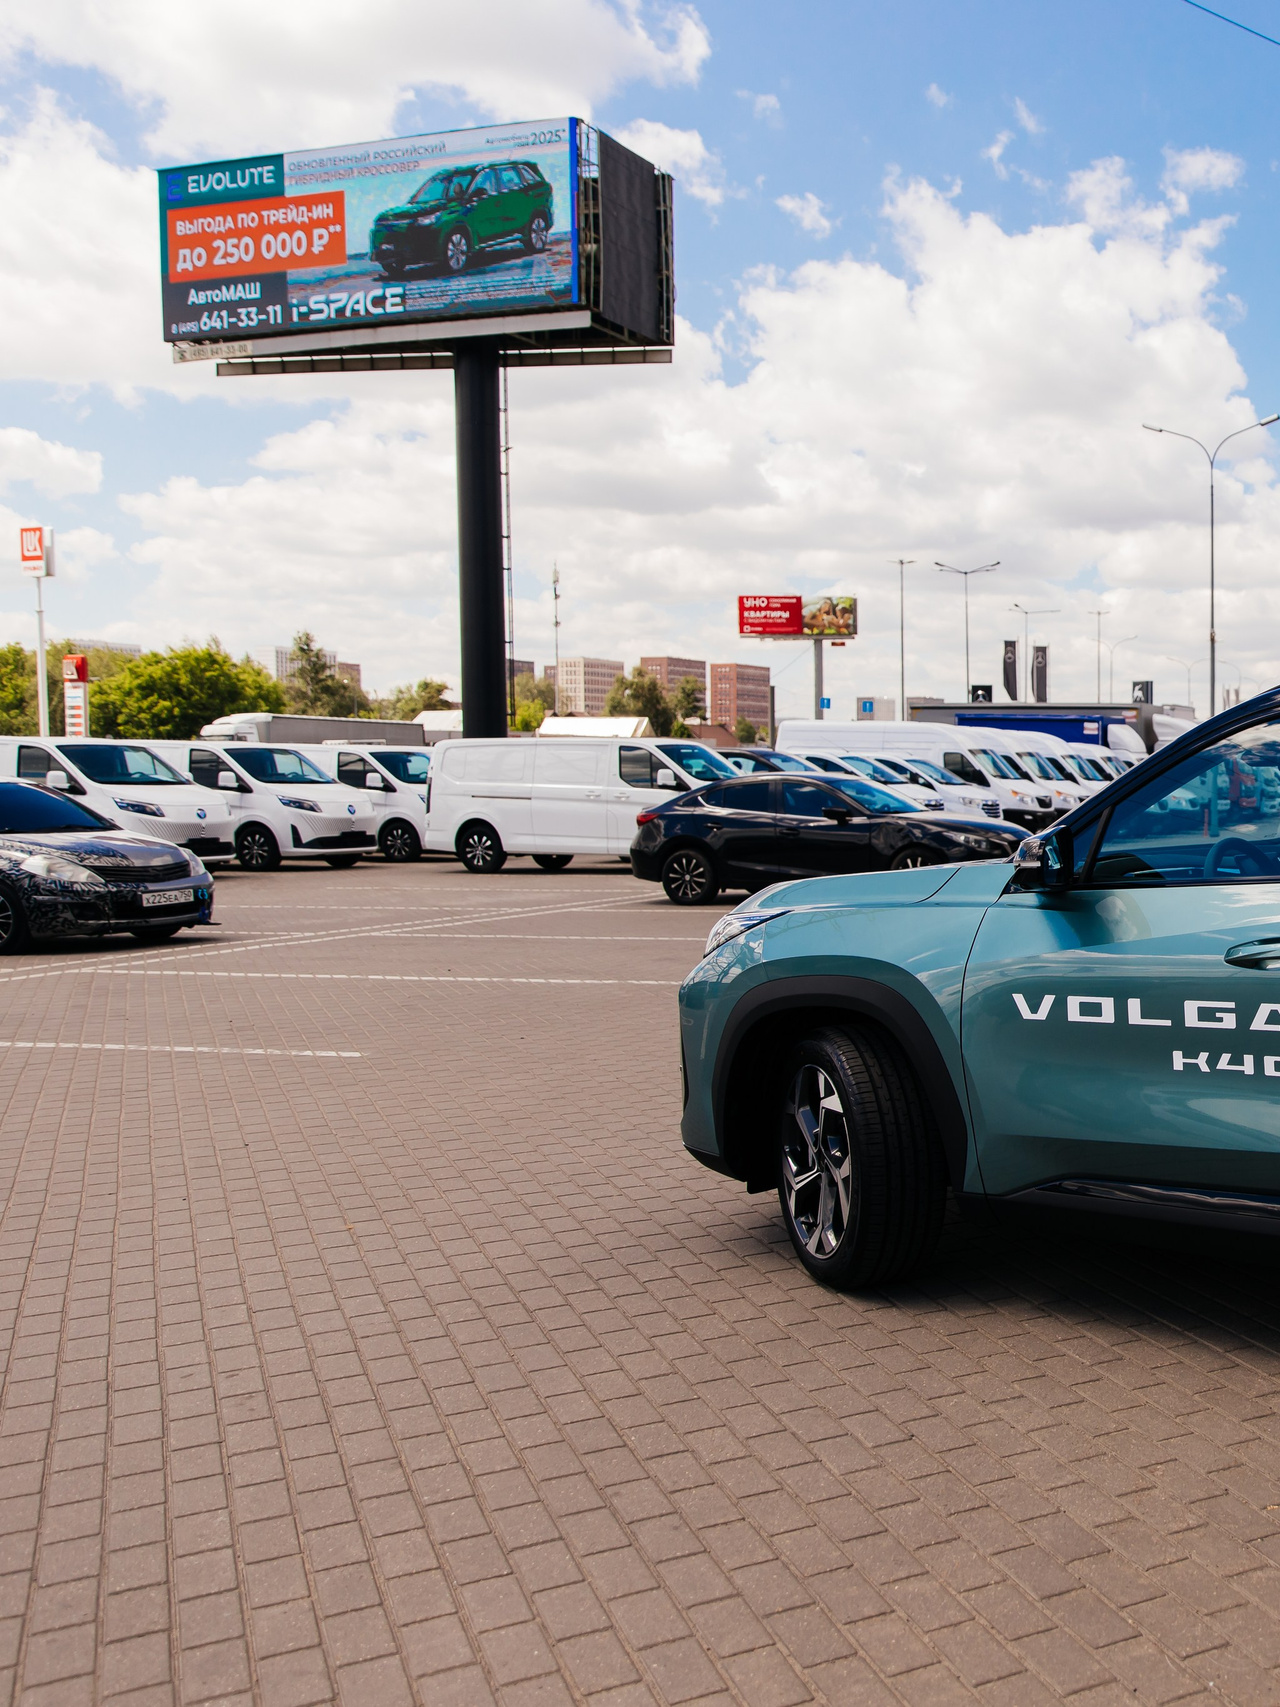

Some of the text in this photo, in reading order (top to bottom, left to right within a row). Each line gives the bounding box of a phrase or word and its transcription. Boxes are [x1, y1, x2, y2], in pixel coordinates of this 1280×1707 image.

[187, 165, 276, 193] EVOLUTE
[176, 203, 334, 236] ВЫГОДА ПО ТРЕЙД-ИН
[212, 236, 255, 266] 250
[260, 229, 307, 260] 000
[187, 281, 262, 305] АвтоМАШ
[291, 286, 406, 323] i-SPACE
[200, 304, 283, 332] 641-33-11
[743, 597, 768, 608] УНО
[744, 610, 790, 619] КВАРТИРЫ
